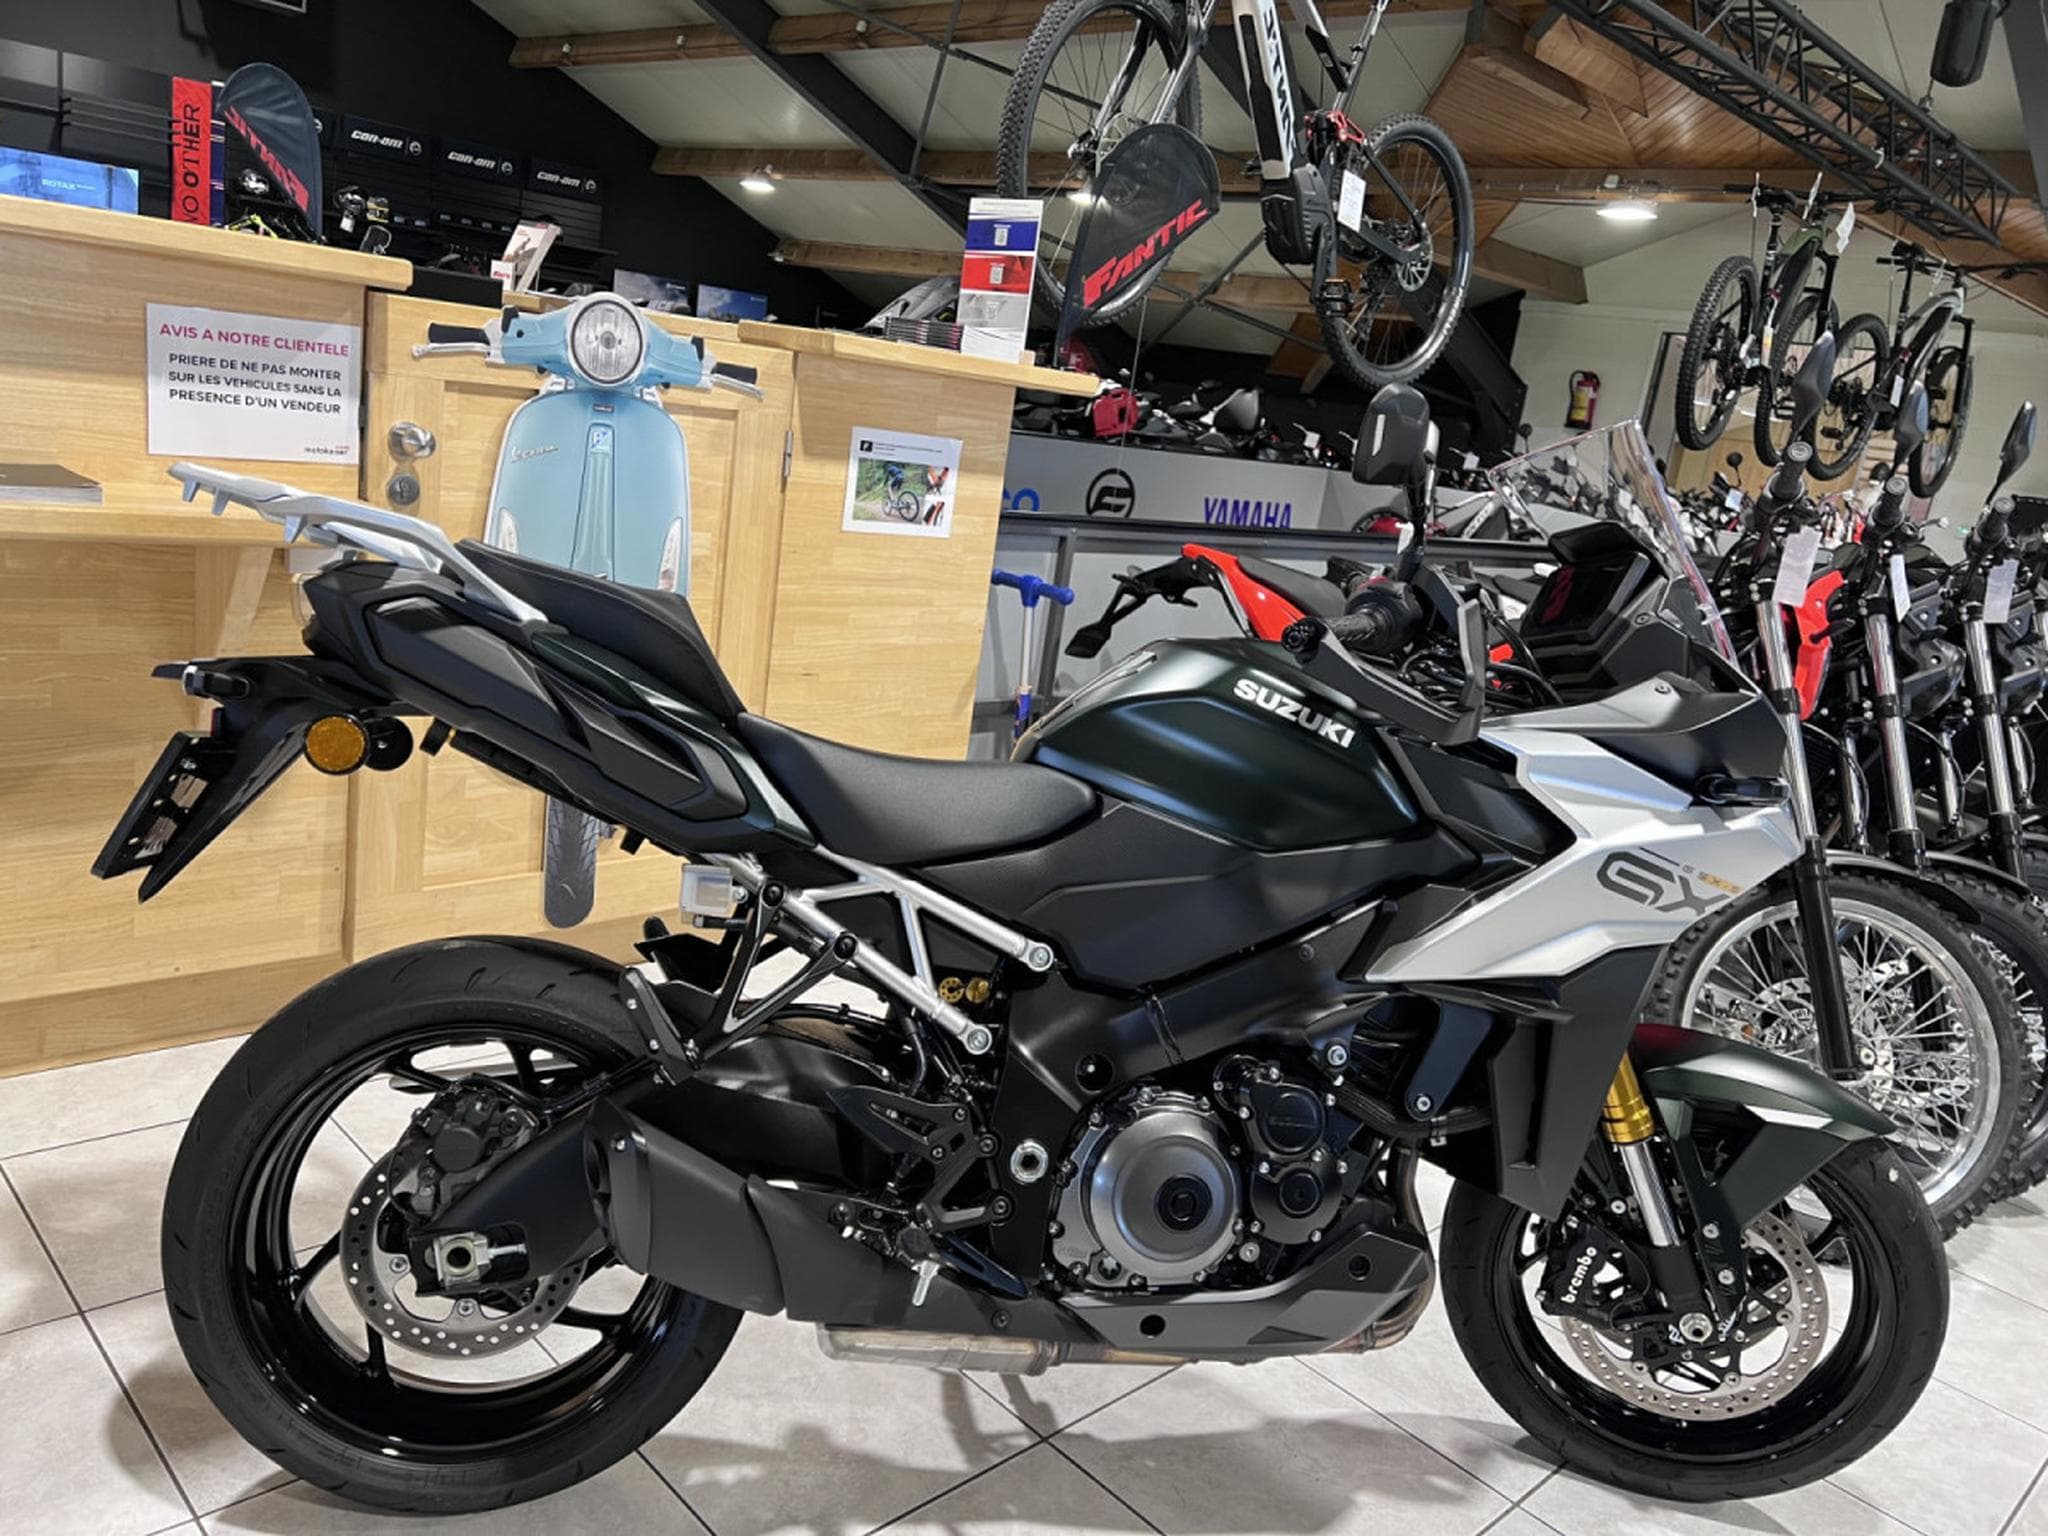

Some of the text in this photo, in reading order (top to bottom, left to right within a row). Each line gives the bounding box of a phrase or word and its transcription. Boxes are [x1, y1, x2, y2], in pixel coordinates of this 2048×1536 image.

[183, 103, 201, 188] OTHER
[351, 129, 404, 149] can-am
[448, 151, 496, 169] can-am
[1083, 198, 1209, 309] FANTIC
[160, 323, 349, 357] AVIS A NOTRE CLIENTELE
[169, 353, 341, 381] PRIERE DE NE PAS MONTER
[169, 371, 341, 397] SUR LES VEHICULES SANS LA
[169, 389, 341, 414] PRESENCE D'UN VENDEUR
[1204, 497, 1291, 528] YAMAHA
[1233, 678, 1356, 749] SUZUKI
[1561, 1246, 1598, 1304] brembo
